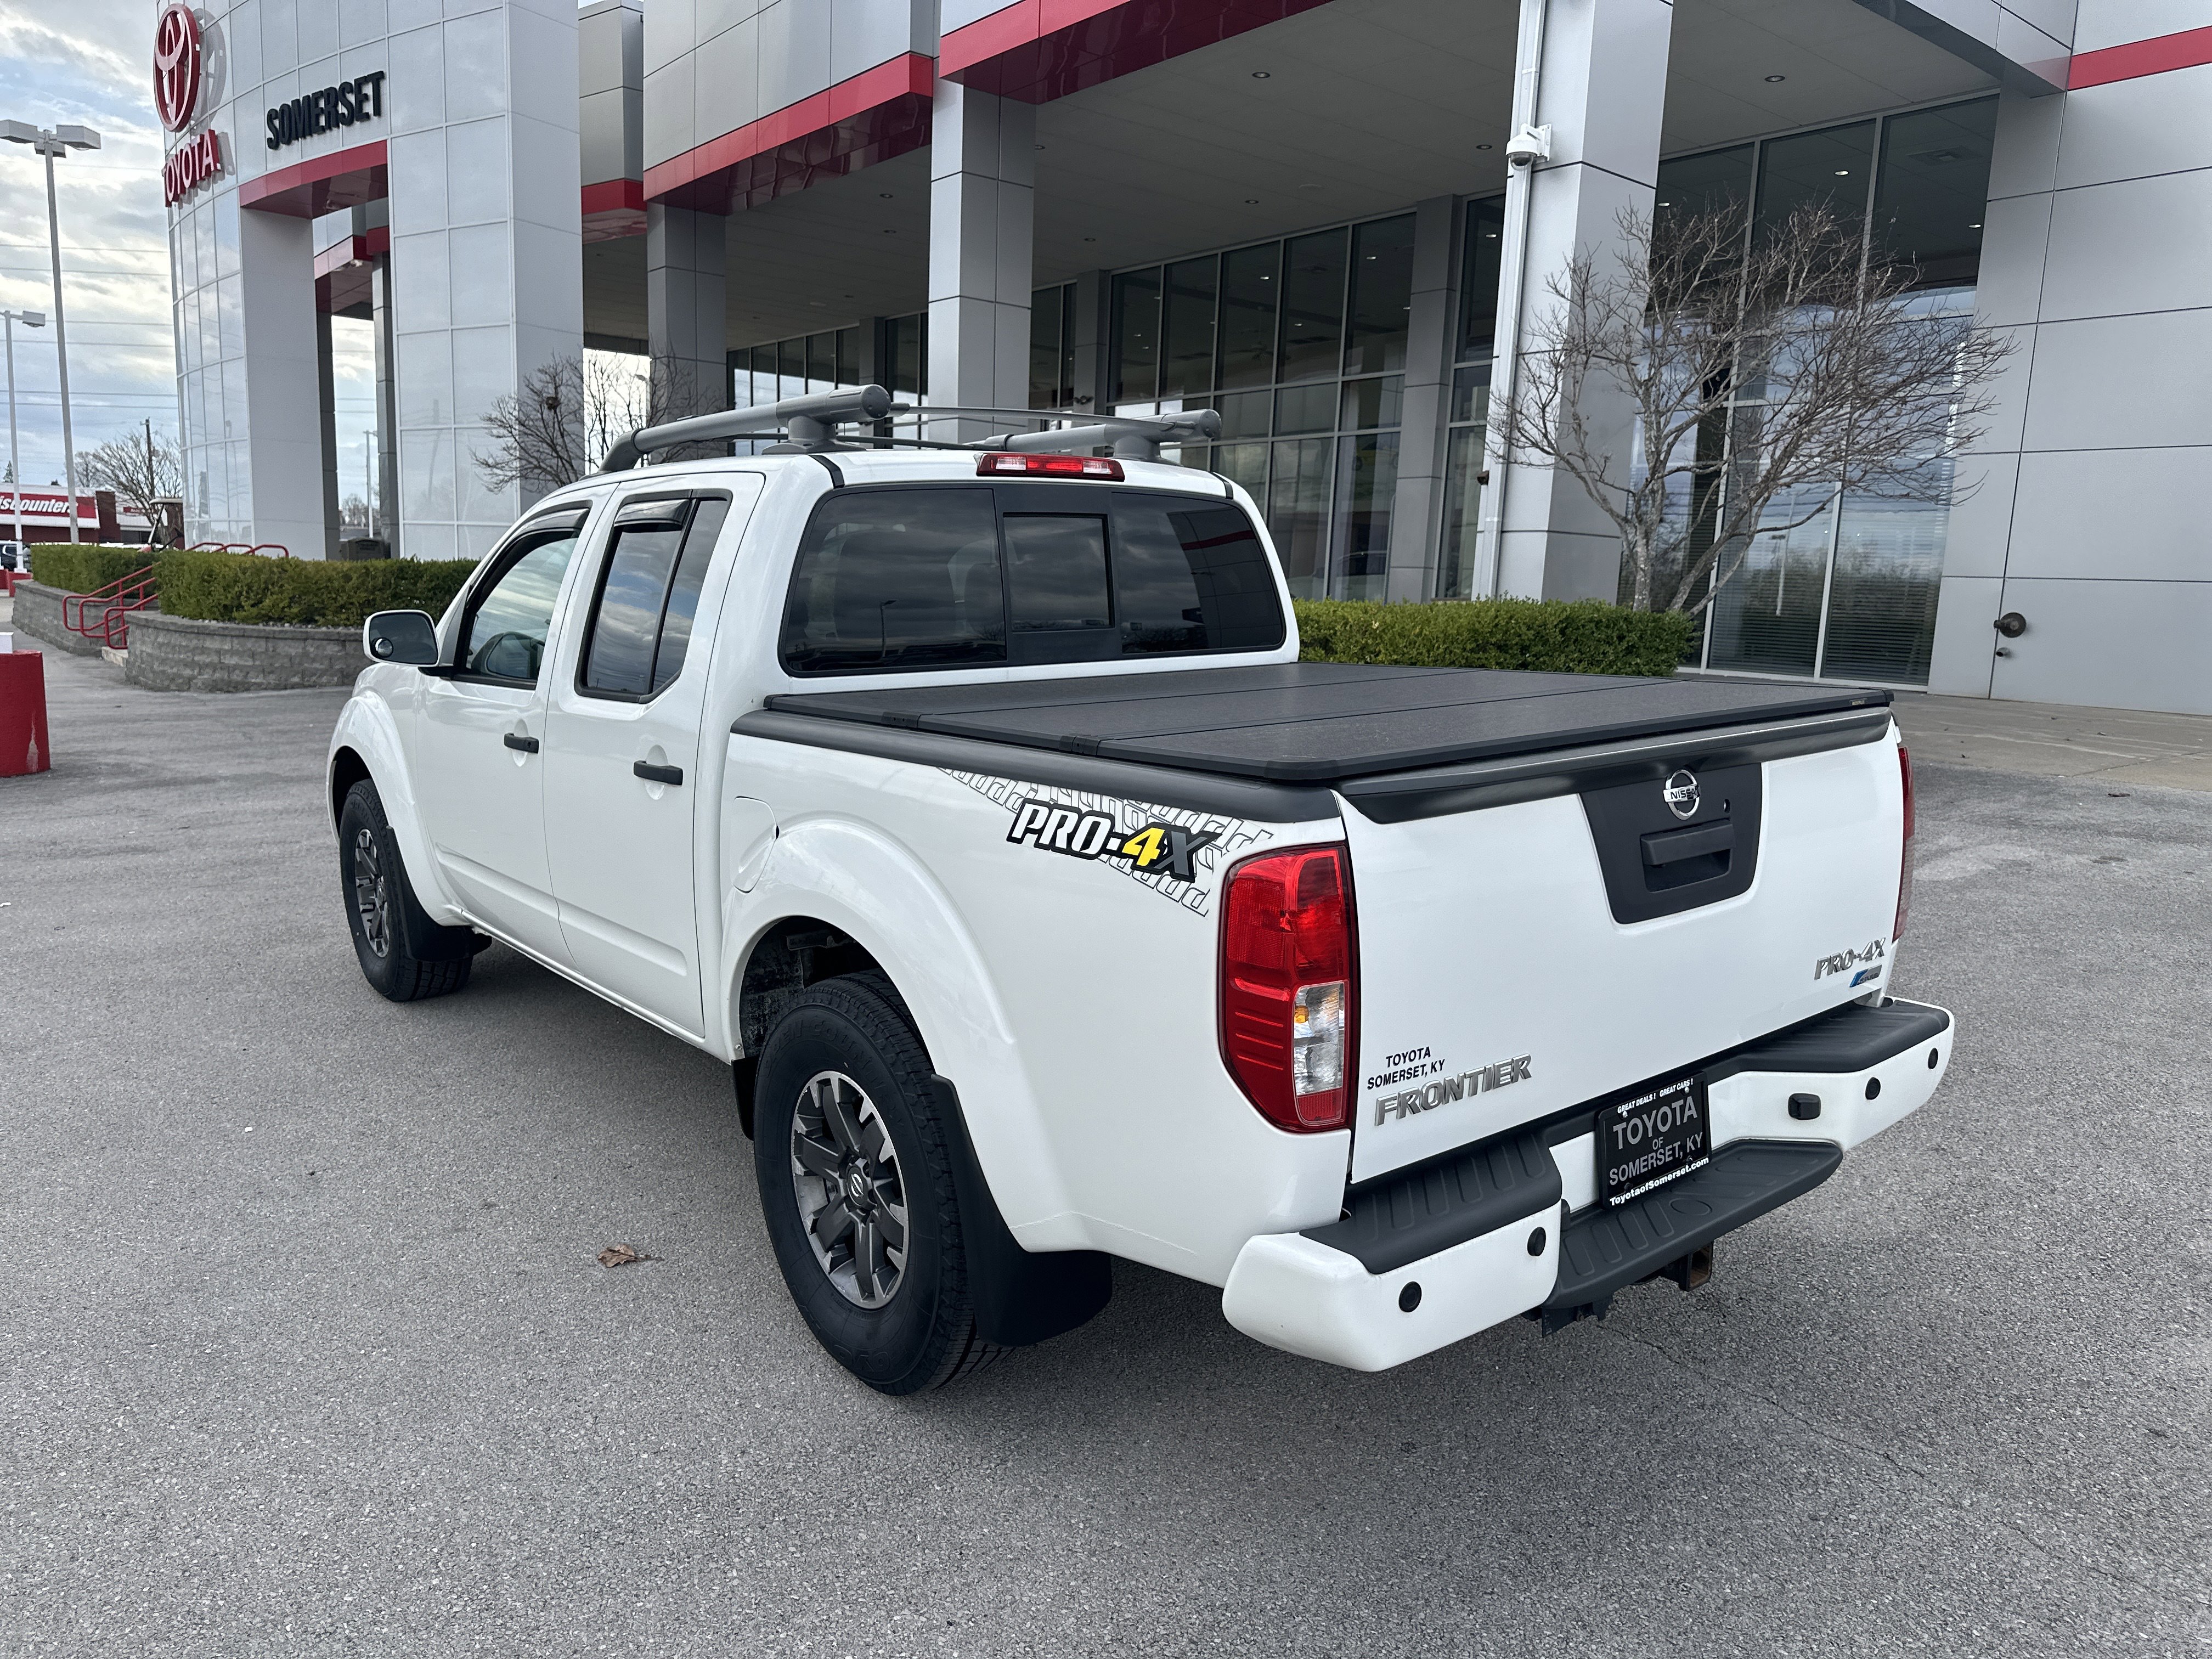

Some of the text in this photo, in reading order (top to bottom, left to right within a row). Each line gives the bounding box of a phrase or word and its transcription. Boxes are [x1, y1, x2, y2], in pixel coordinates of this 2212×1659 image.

[267, 70, 386, 150] SOMERSET
[162, 128, 220, 205] OYOTA
[0, 495, 78, 514] iscounter
[1007, 799, 1221, 882] PRO-4X
[1814, 937, 1886, 980] PRO-4X
[1367, 1059, 1446, 1090] SOMERSET, KY
[1386, 1046, 1431, 1068] TOYOTA
[1374, 1053, 1532, 1126] FRONTIER
[1617, 1101, 1635, 1113] GREAT
[1660, 1084, 1677, 1097] GREAT
[1613, 1096, 1698, 1149] TOYOTA
[1652, 1137, 1664, 1150] OF
[1609, 1132, 1703, 1186] SOMERSET, KY
[1610, 1157, 1709, 1206] ToyotaofSomerset.com
